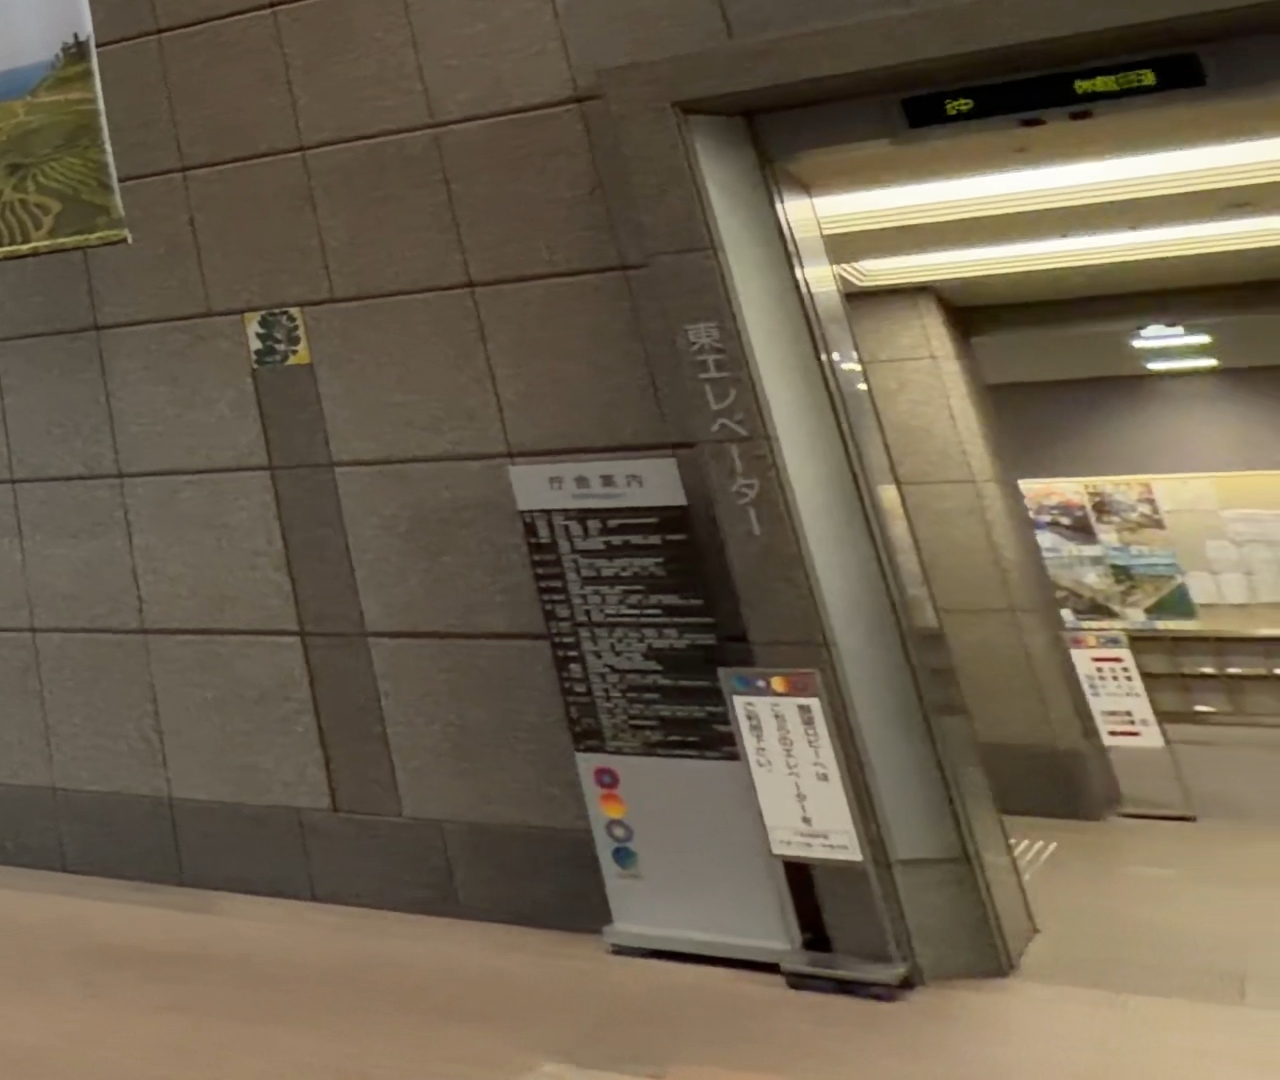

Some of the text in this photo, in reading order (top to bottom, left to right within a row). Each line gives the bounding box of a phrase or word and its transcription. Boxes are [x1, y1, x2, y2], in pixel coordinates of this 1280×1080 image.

[683, 322, 762, 537] 東エレベーター
